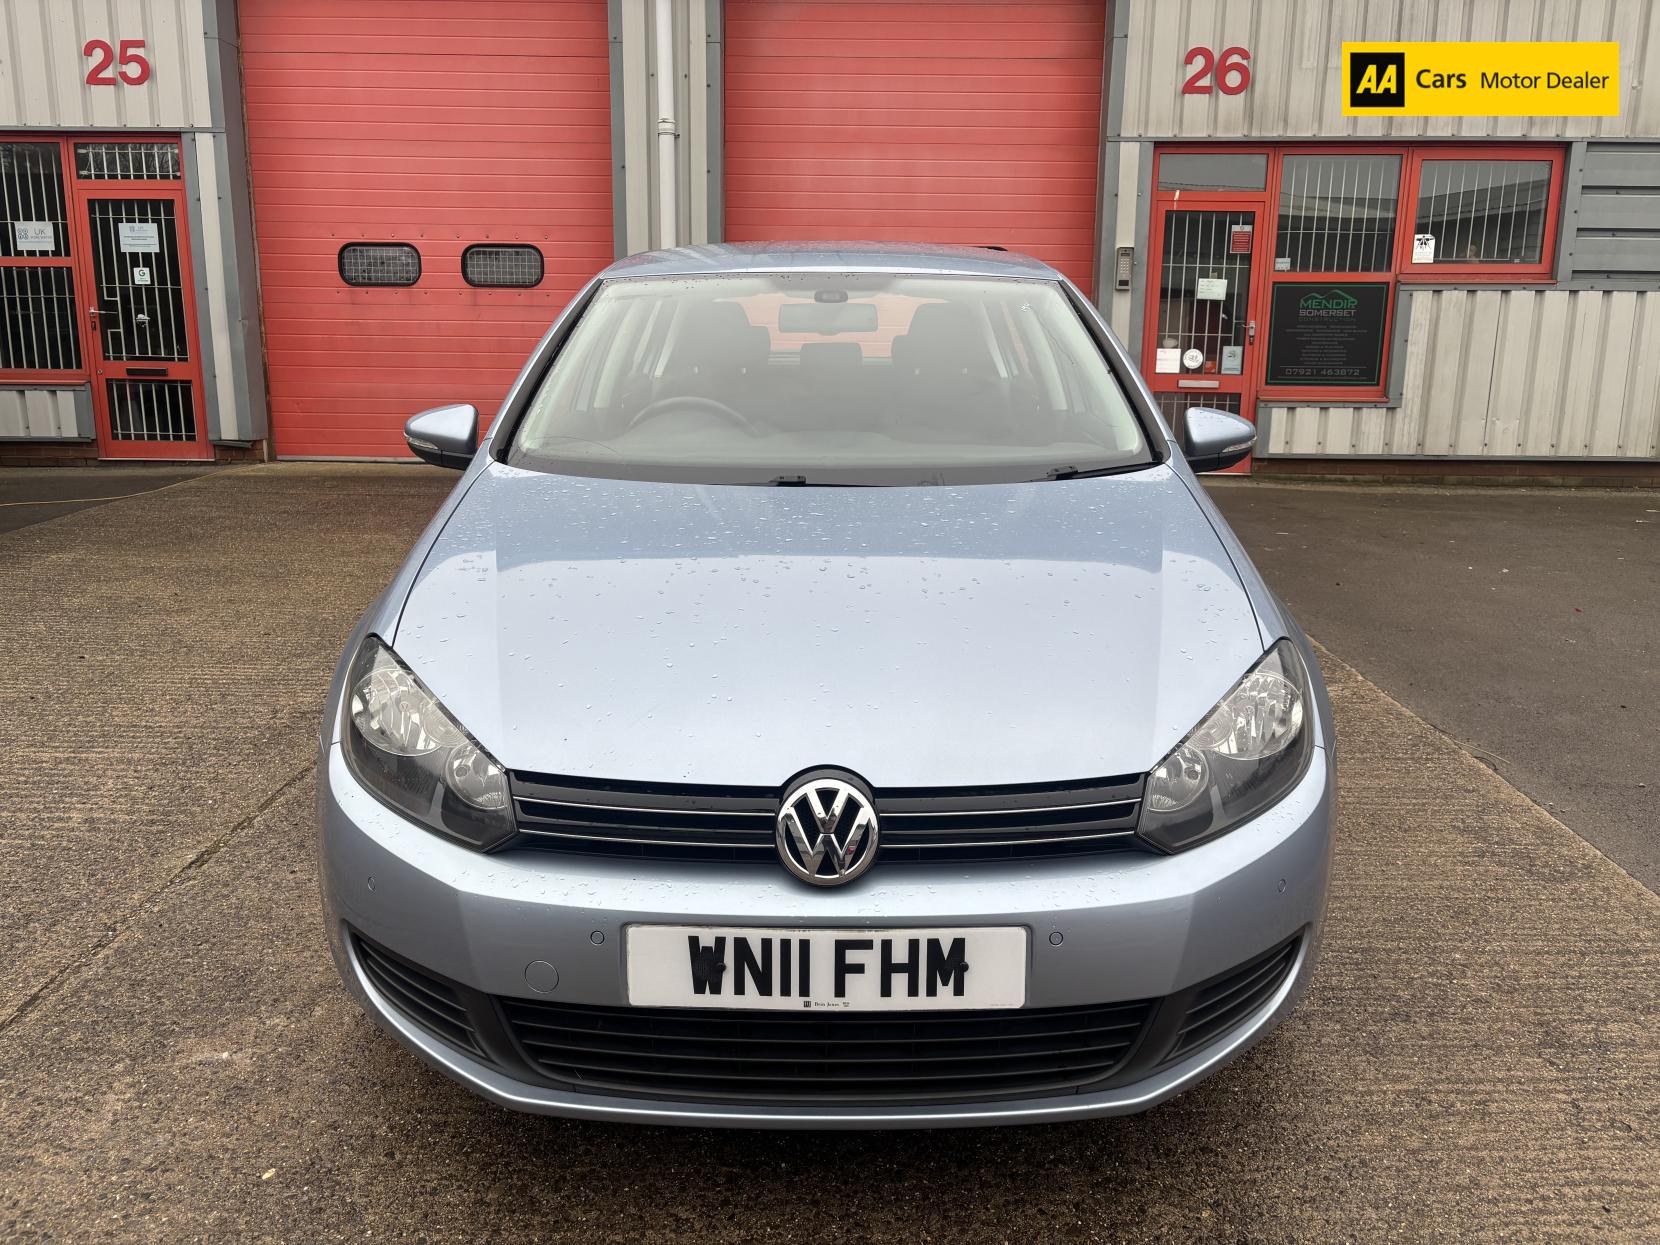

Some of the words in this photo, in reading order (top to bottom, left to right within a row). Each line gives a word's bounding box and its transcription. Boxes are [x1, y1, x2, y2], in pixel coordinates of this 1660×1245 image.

[83, 39, 151, 86] 25
[1184, 46, 1252, 95] 26
[1298, 309, 1357, 317] SOMERSET
[1299, 299, 1358, 309] MENDIP
[1285, 368, 1317, 376] 07921
[1320, 368, 1361, 376] 463872
[687, 934, 811, 998] WN11
[833, 936, 968, 999] FHM
